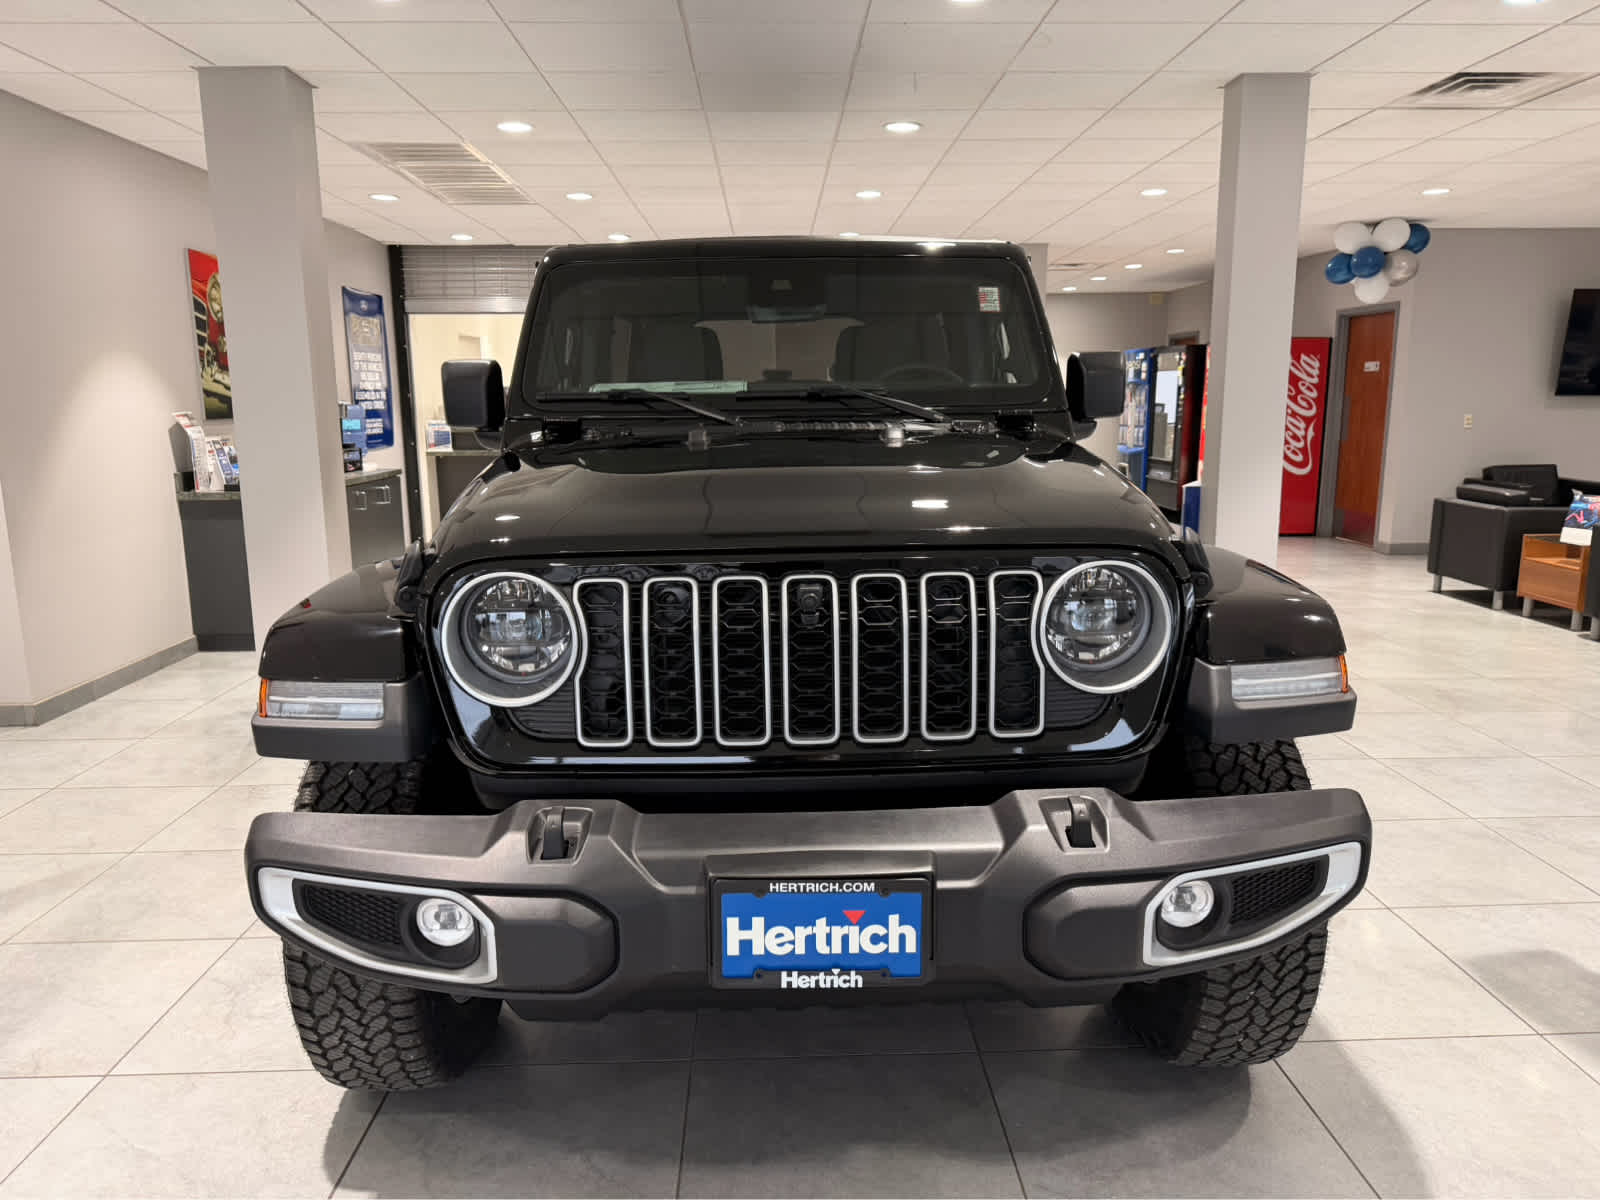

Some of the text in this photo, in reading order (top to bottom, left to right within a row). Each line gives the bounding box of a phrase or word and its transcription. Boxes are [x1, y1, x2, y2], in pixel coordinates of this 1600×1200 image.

[769, 882, 875, 893] HERTRICH.COM
[726, 910, 917, 956] Hertrich
[780, 968, 864, 989] Hertrich
